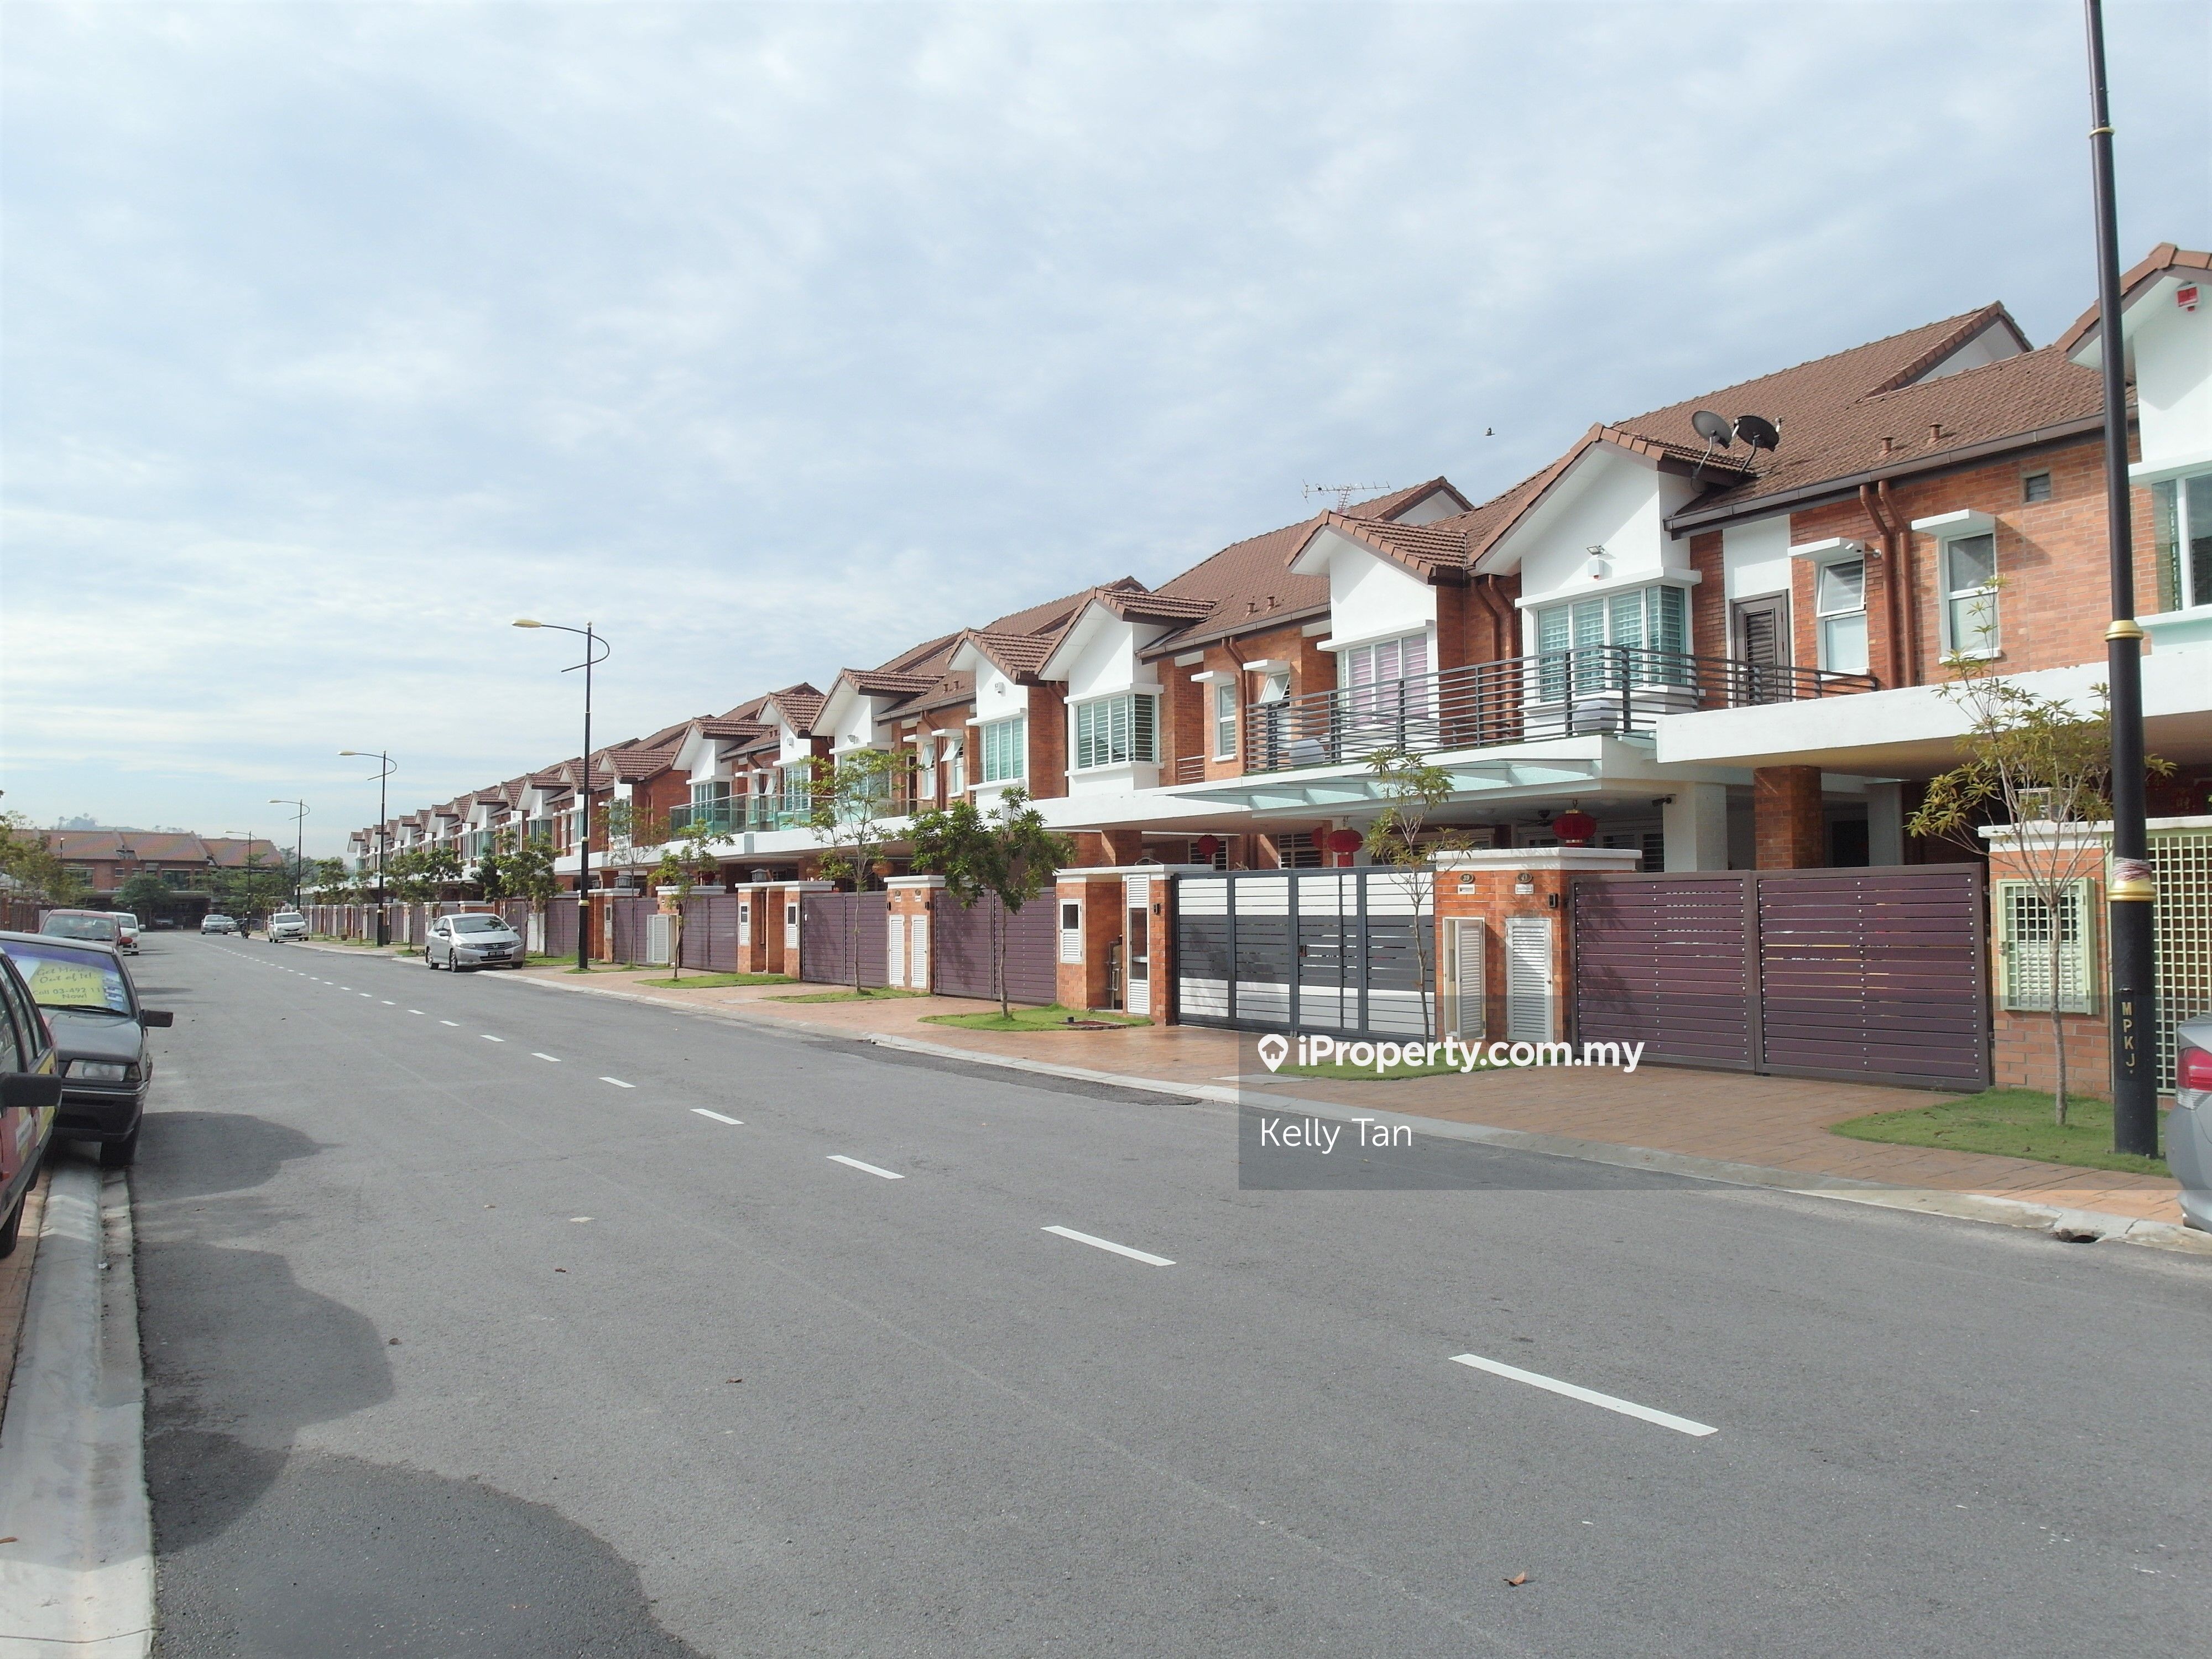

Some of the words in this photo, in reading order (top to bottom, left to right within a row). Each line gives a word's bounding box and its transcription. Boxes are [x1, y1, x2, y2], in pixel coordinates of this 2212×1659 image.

[40, 975, 61, 984] Out
[66, 973, 77, 982] of
[2121, 1002, 2136, 1067] MPKJ
